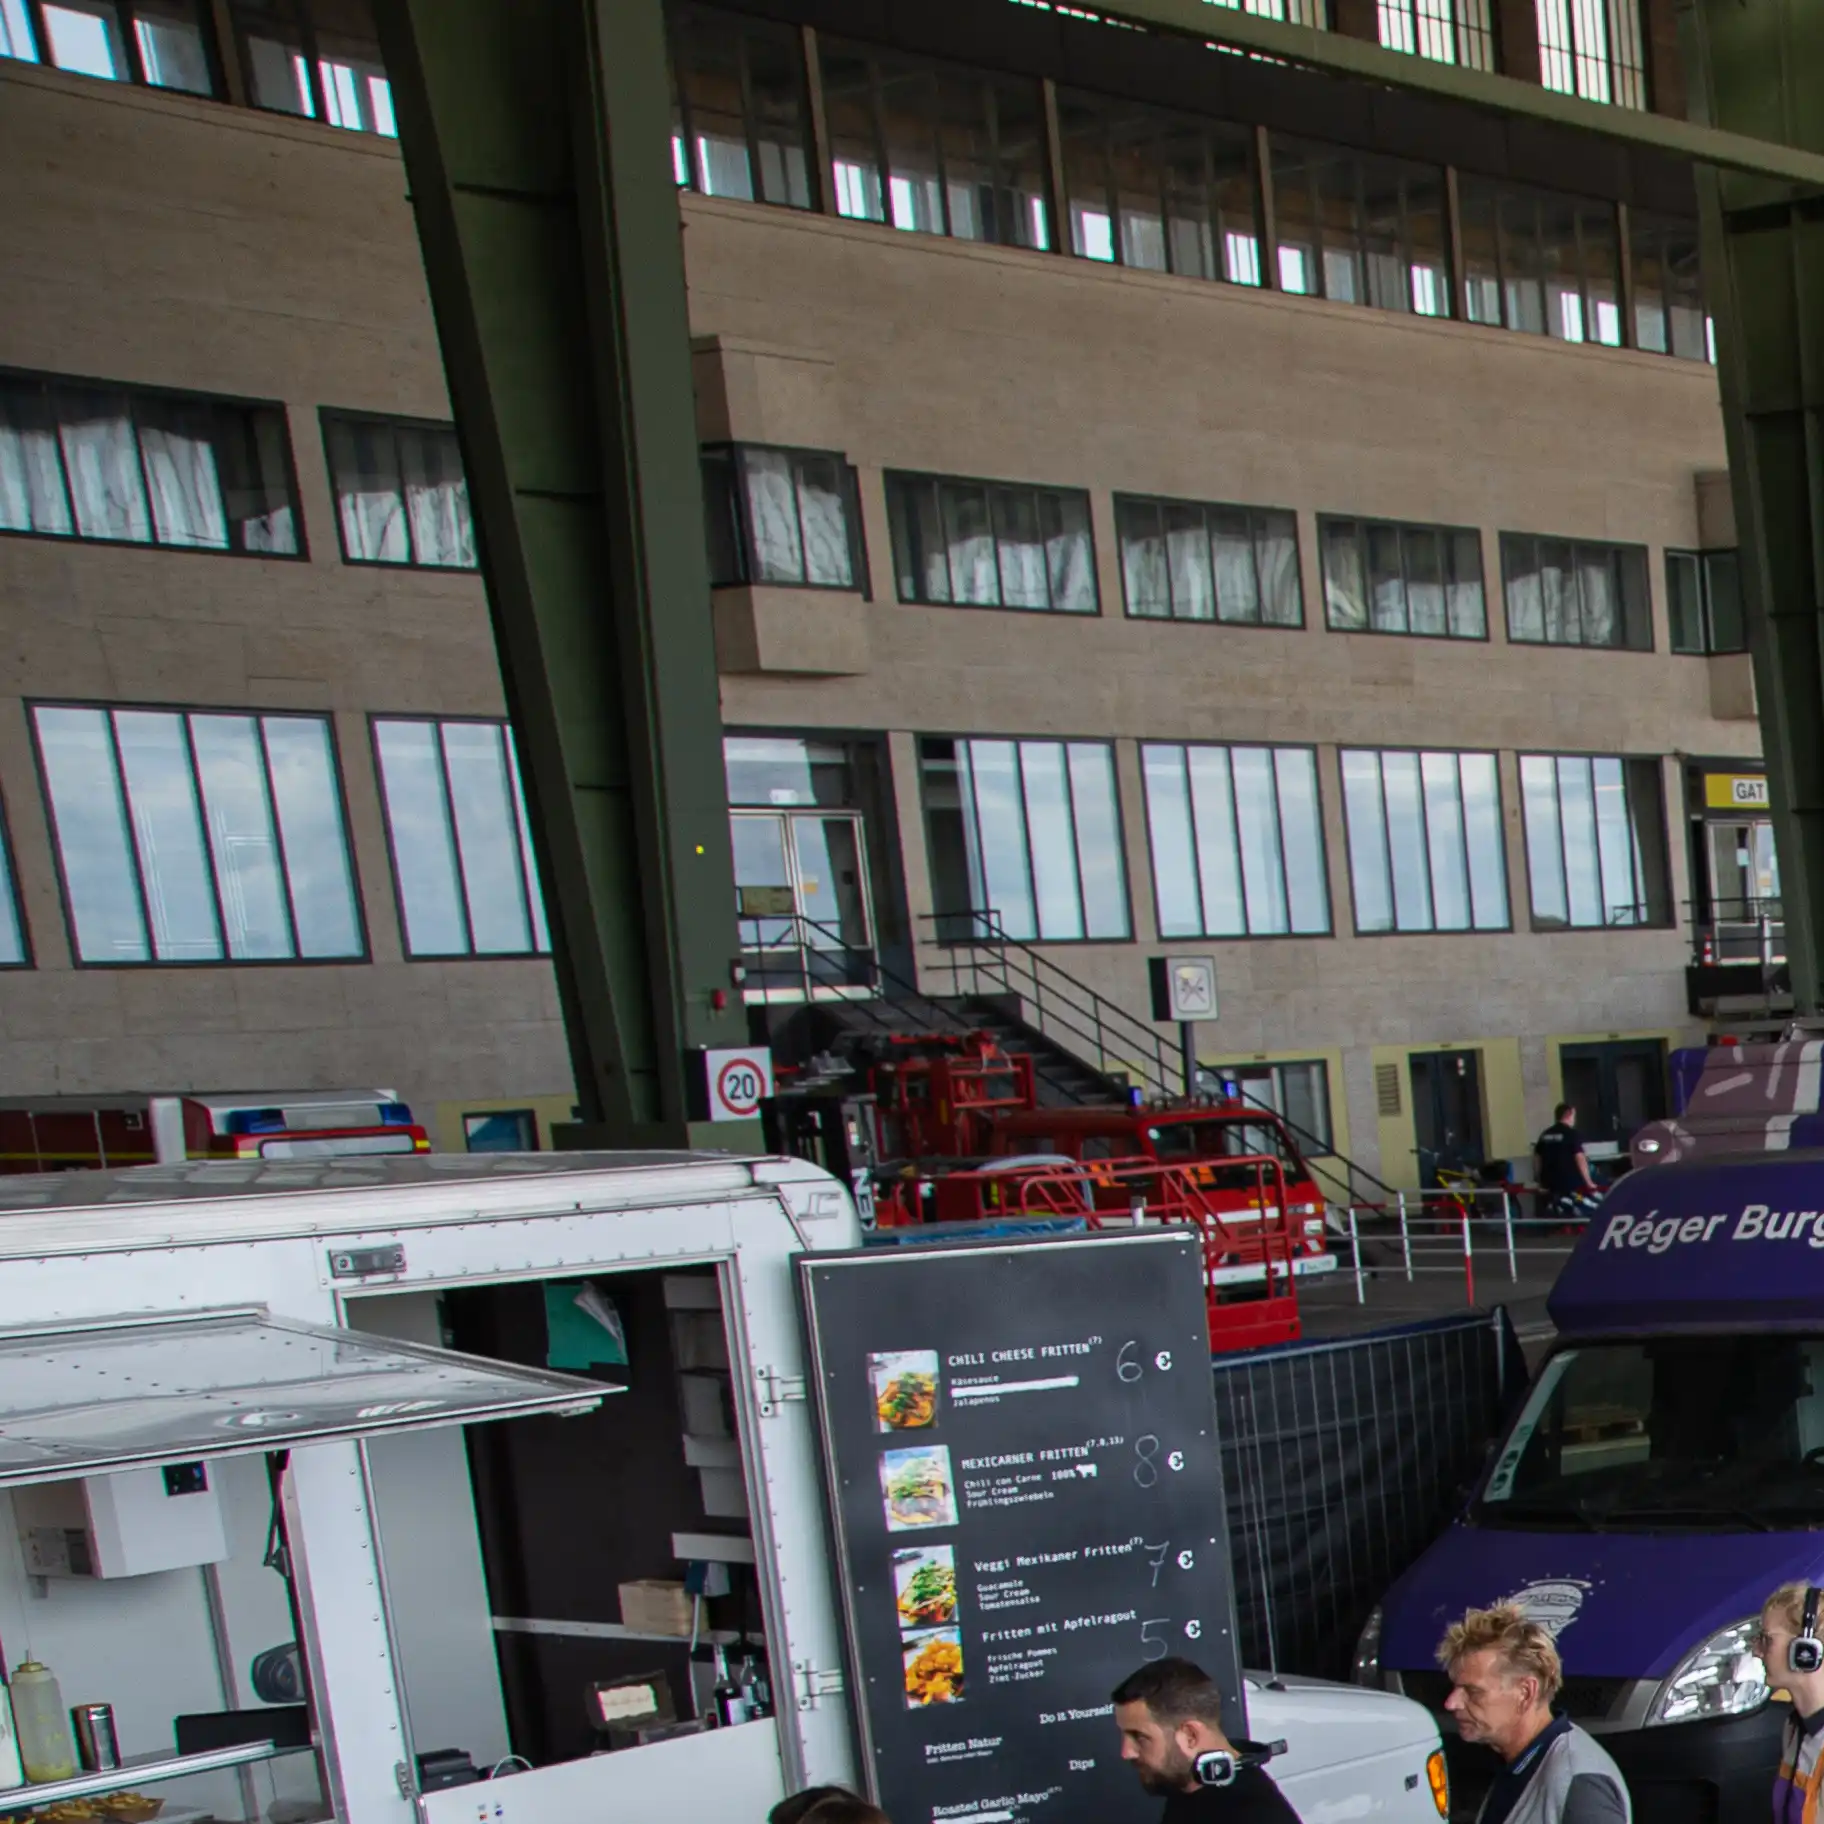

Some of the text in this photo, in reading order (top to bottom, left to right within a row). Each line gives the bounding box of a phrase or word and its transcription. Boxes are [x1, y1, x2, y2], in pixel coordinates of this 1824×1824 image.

[728, 1073, 755, 1100] 20
[1599, 1210, 1728, 1254] Réger
[949, 1353, 985, 1367] CHILI
[992, 1347, 1035, 1362] CHEESE
[1116, 1340, 1172, 1383] 6 €
[961, 1453, 1034, 1470] MEXICARNER
[1133, 1434, 1184, 1488] 8 €
[1016, 1473, 1042, 1485] Carne
[974, 1559, 1011, 1573] Veggi
[1016, 1550, 1078, 1568] Mexikaner
[1144, 1540, 1194, 1588] 7 €
[981, 1609, 1137, 1643] Fritten mit Apfelragout
[1140, 1618, 1201, 1662] 5 €
[1039, 1713, 1056, 1725] Do
[1067, 1703, 1115, 1720] Yourself
[925, 1736, 1003, 1756] Fritten Natur
[1069, 1758, 1095, 1771] Dips
[932, 1800, 979, 1817] Roasted
[980, 1795, 1015, 1810] Garlic
[1017, 1790, 1050, 1805] Mayo
